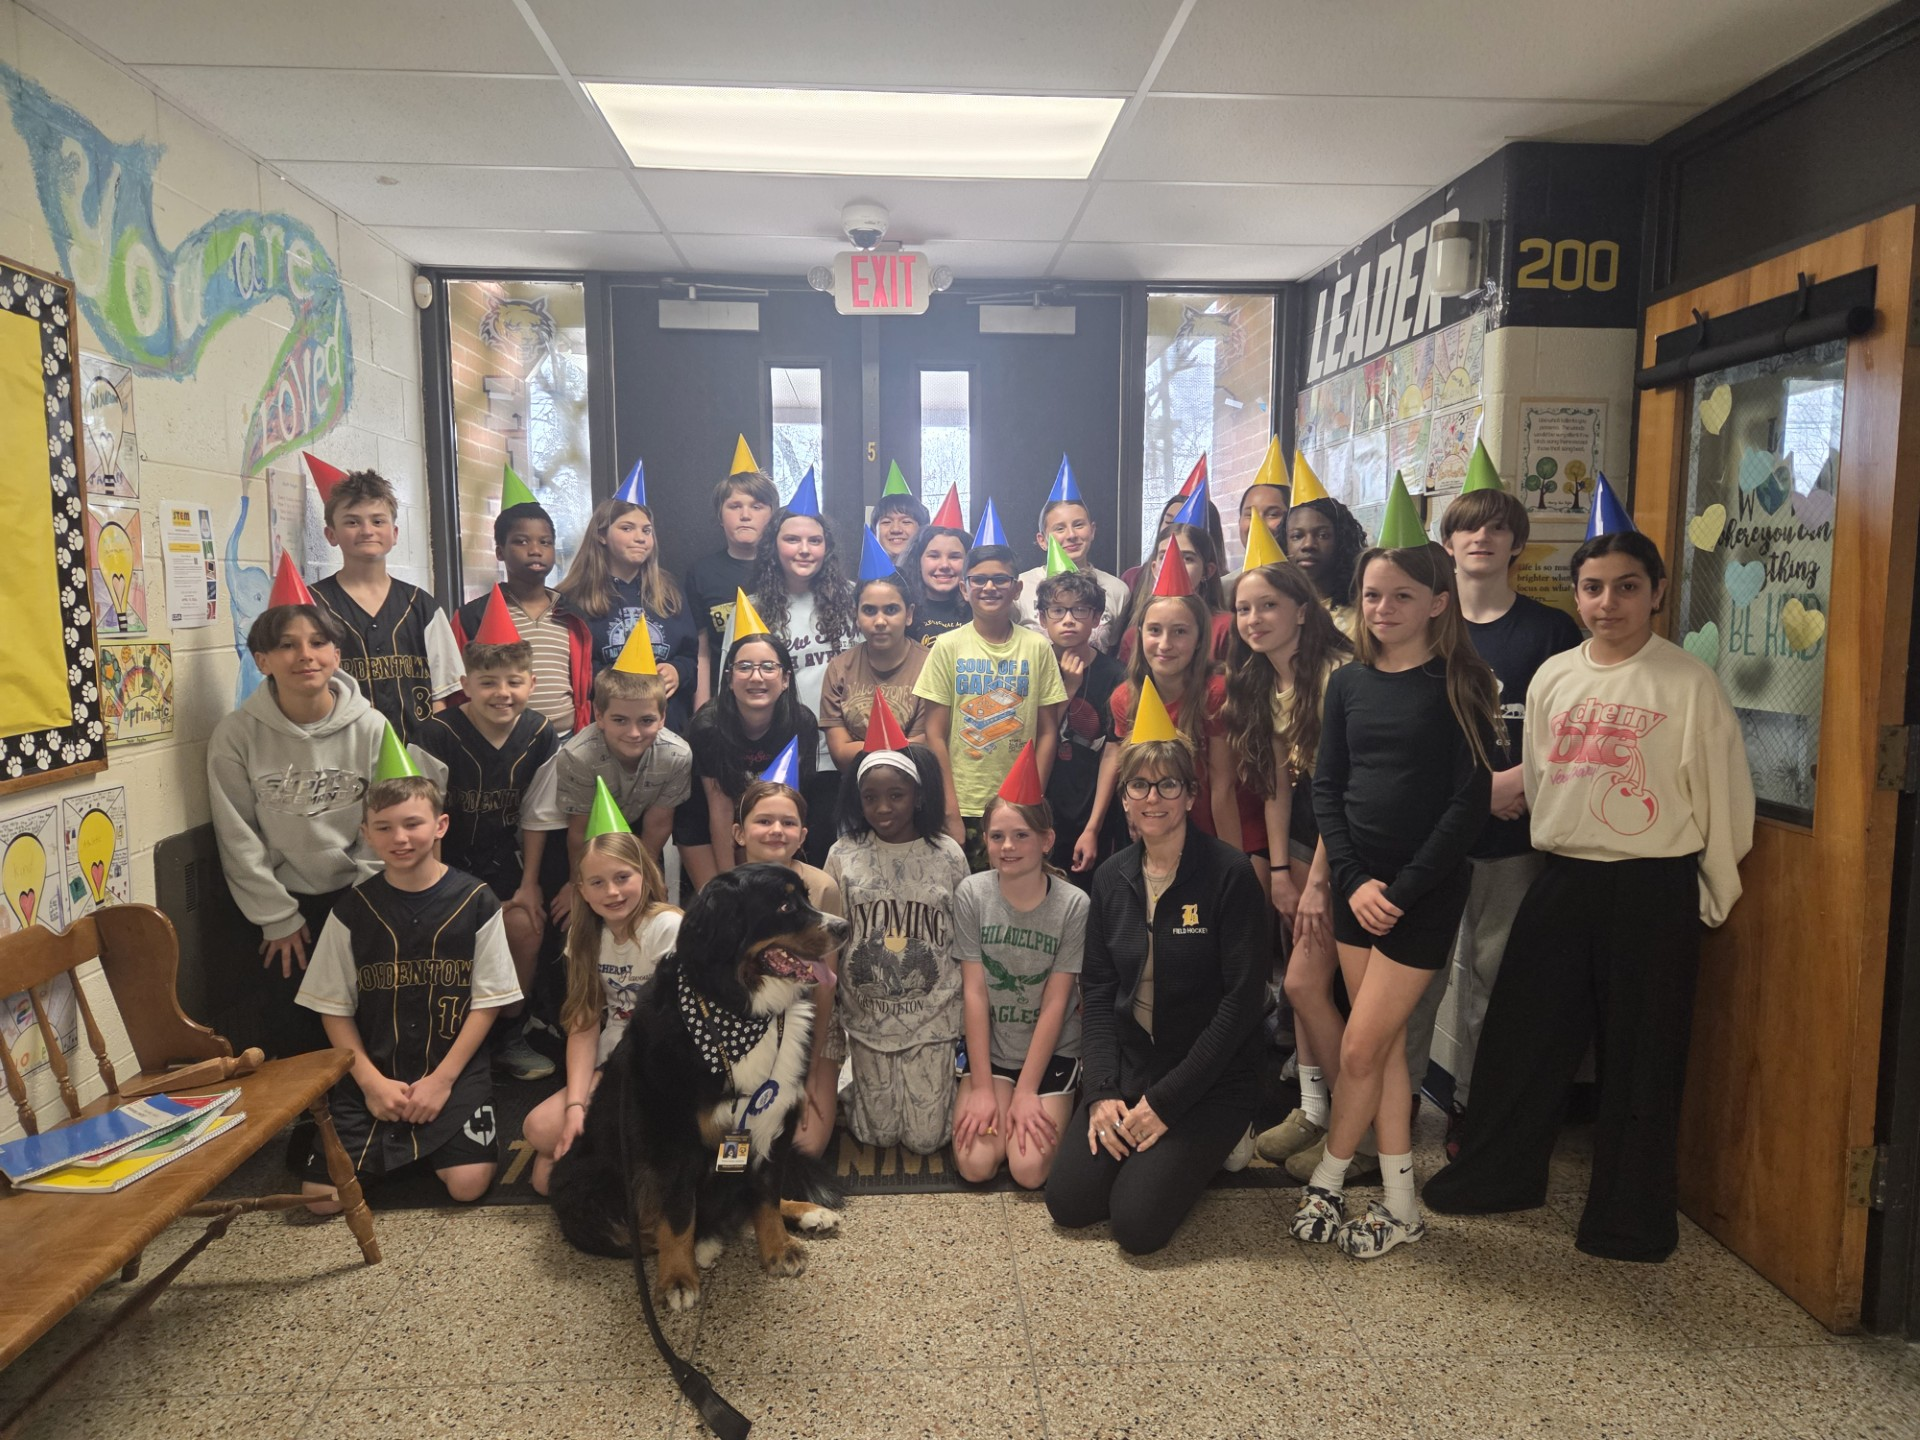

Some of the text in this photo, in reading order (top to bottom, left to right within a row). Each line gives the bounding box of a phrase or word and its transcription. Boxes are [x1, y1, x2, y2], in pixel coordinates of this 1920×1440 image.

[232, 223, 315, 301] are
[1517, 238, 1620, 292] 200
[850, 255, 916, 307] EXIT
[867, 441, 876, 462] 5
[172, 511, 190, 521] STEM
[1759, 525, 1796, 556] you
[1534, 562, 1541, 571] is
[1516, 584, 1537, 592] focus
[1552, 584, 1571, 592] what
[1517, 574, 1549, 583] brighter
[340, 655, 431, 681] RDENTOWN
[955, 658, 1030, 675] SOUL OF A
[955, 673, 1030, 697] GAMER
[1569, 697, 1667, 739] cherry
[980, 925, 1060, 956] HILADELPHI
[1172, 927, 1186, 935] FIELD
[991, 1004, 1041, 1025] AGLES
